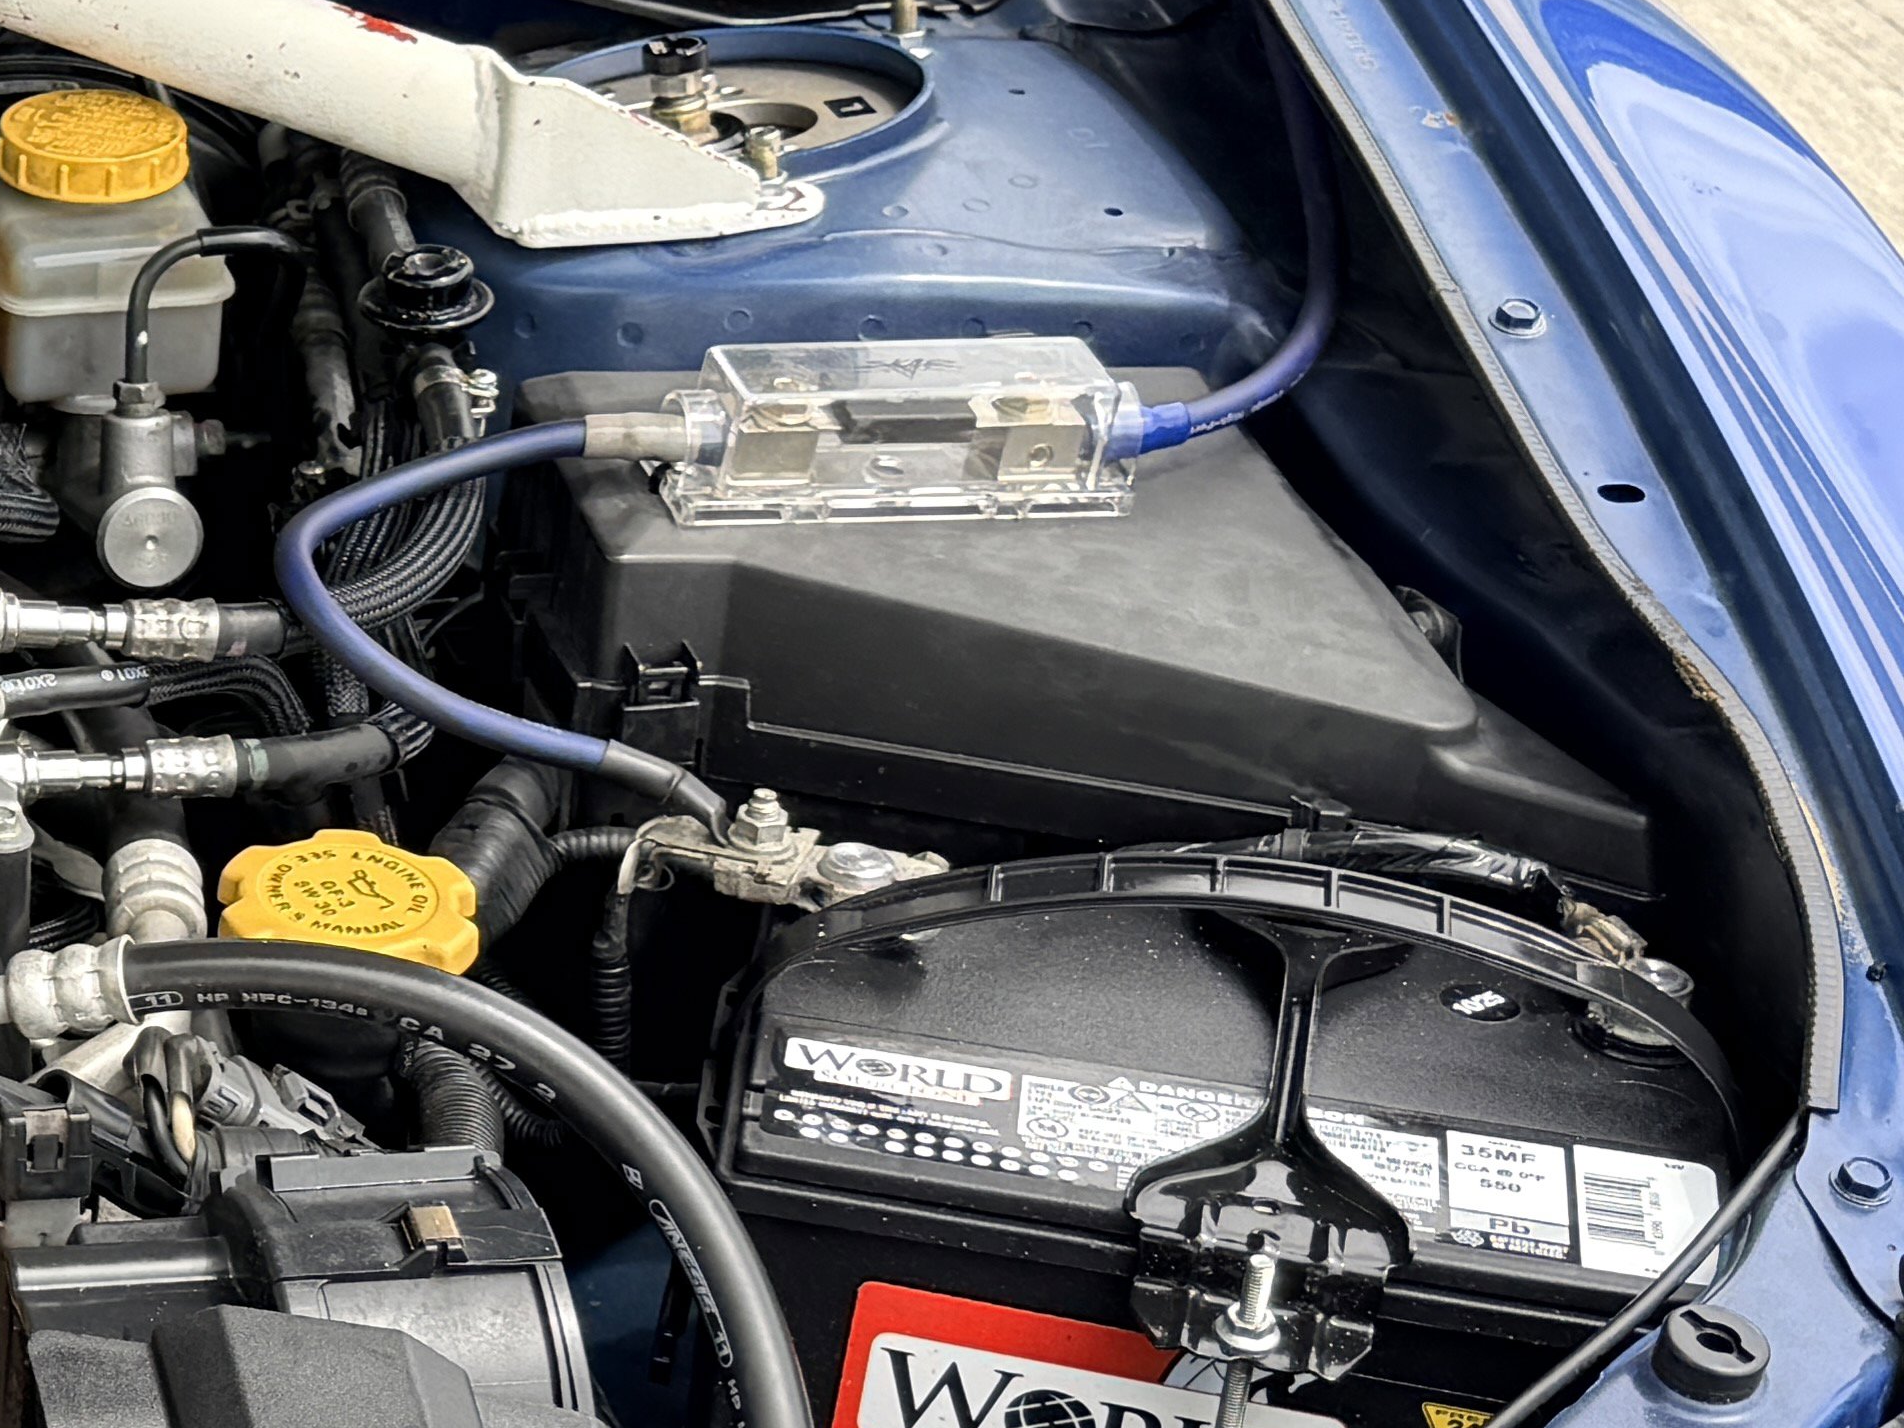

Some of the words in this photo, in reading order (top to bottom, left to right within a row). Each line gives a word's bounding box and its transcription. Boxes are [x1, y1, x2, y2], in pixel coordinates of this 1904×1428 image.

[406, 894, 429, 915] OIL
[310, 919, 406, 935] MANUAL
[197, 992, 229, 1003] HP
[1460, 1143, 1537, 1163] 35MF
[1454, 1162, 1490, 1175] CCA
[1488, 1217, 1531, 1235] Pb
